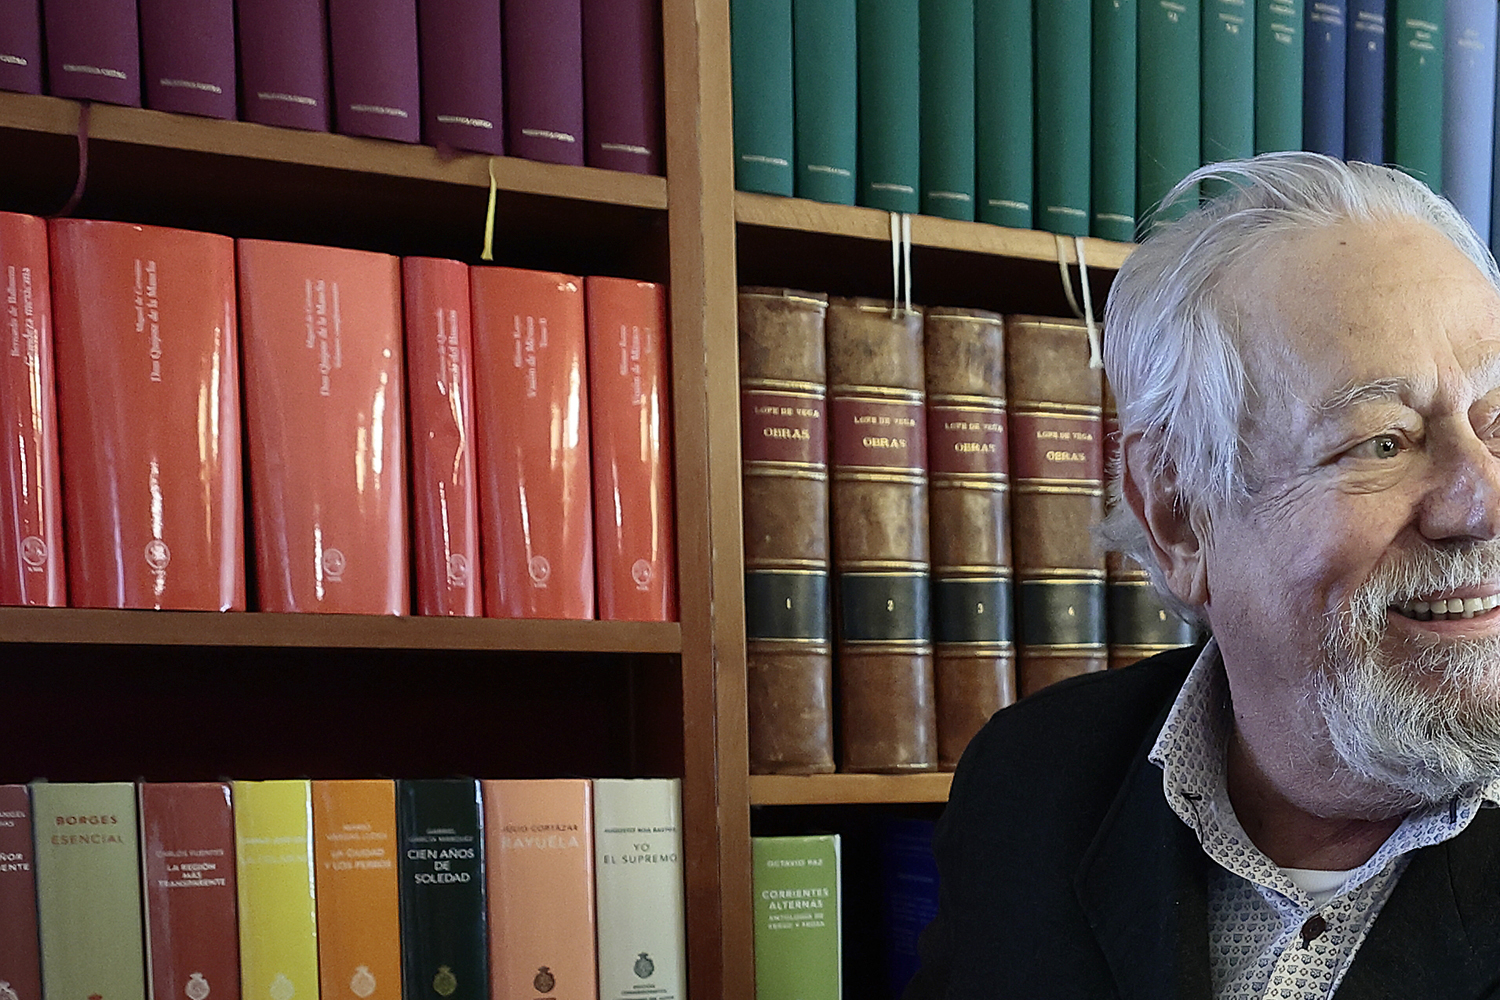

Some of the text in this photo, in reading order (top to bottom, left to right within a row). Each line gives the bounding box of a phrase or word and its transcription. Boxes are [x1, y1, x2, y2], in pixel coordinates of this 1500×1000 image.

[763, 428, 811, 440] OBRAS
[862, 437, 908, 449] OBRAS
[954, 442, 996, 454] OBRAS
[1045, 451, 1086, 462] OBRAS
[55, 815, 118, 826] BORGES
[50, 834, 125, 846] ESENCIAL
[502, 836, 580, 851] RAYUELA
[407, 846, 475, 861] CIEN AÑOS
[632, 844, 651, 853] YO
[604, 854, 679, 865] EL SUPREMO
[434, 862, 451, 872] DE
[414, 872, 471, 885] SOLEDAD
[762, 888, 829, 900] CORRIENTES
[768, 900, 824, 911] ALTERNAS
